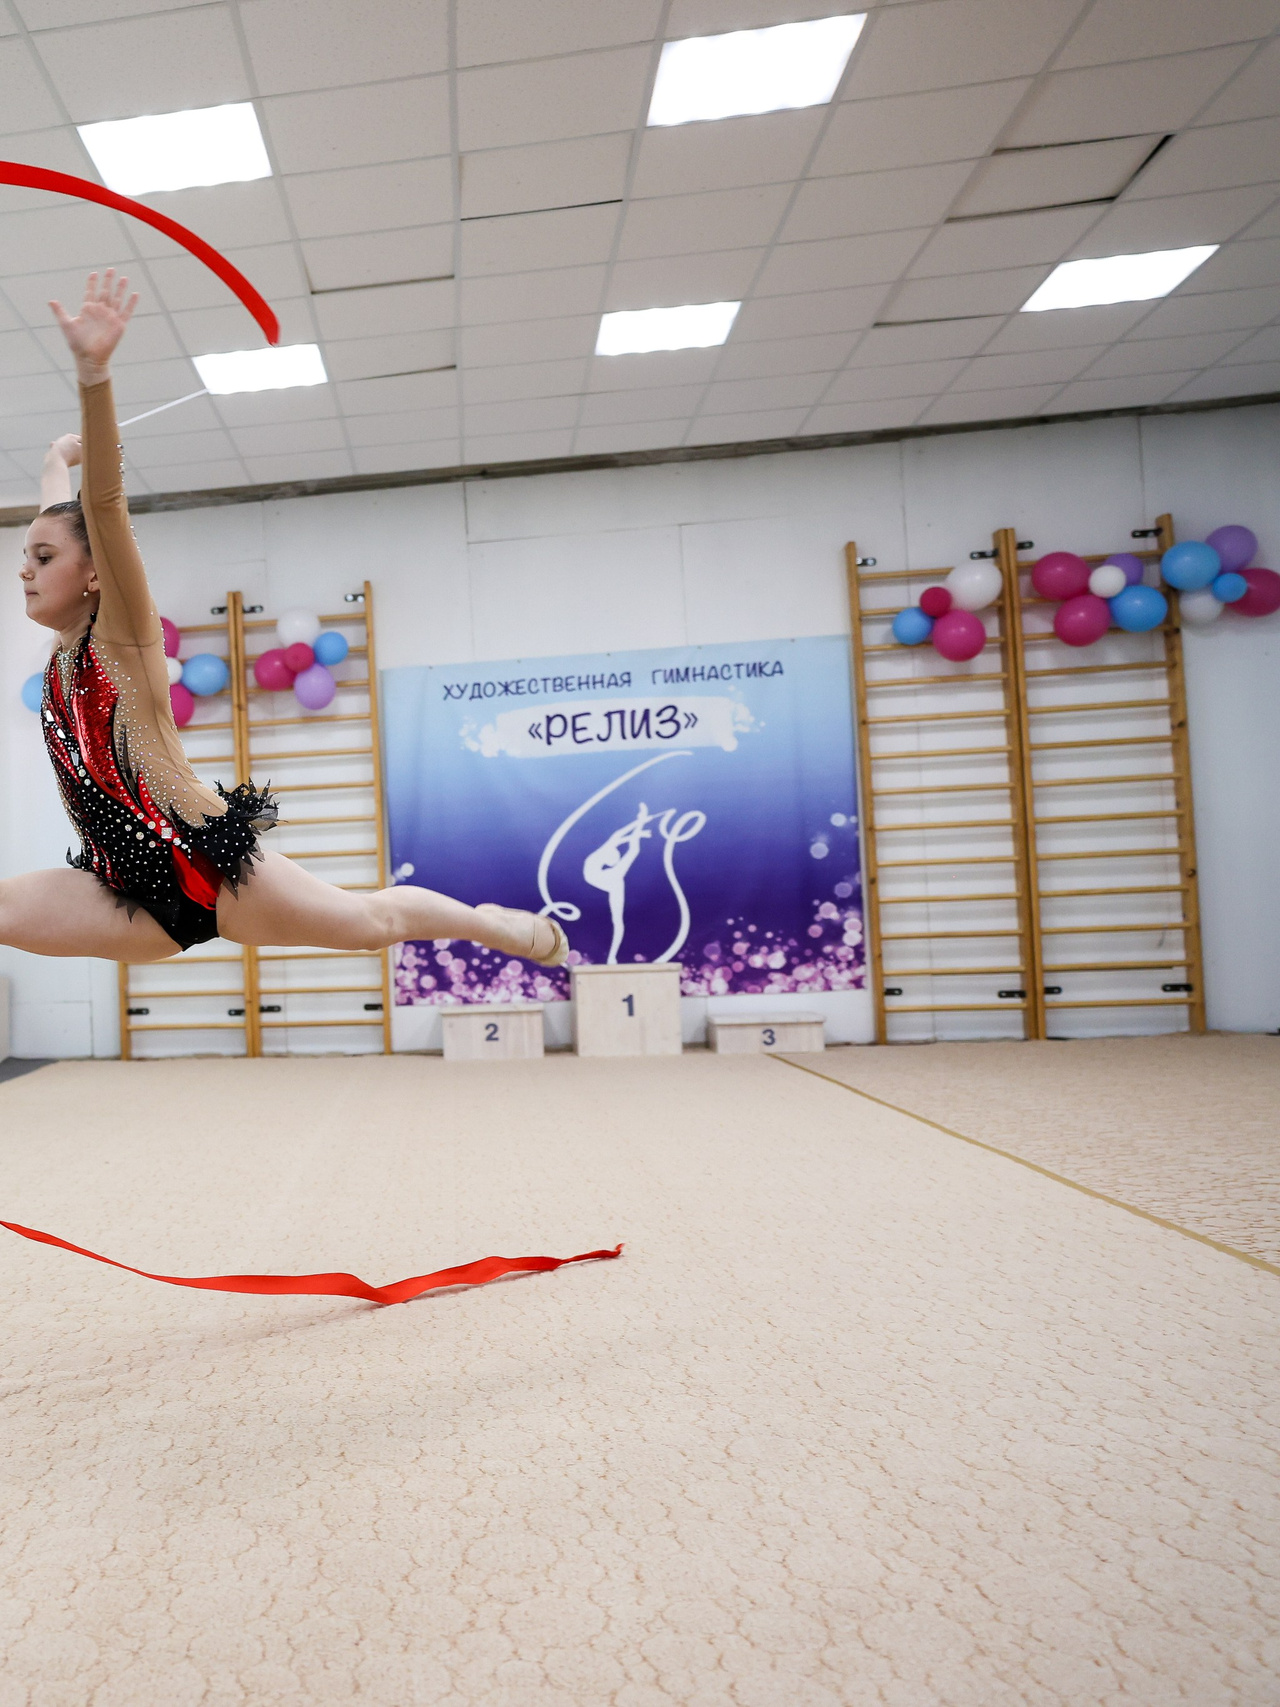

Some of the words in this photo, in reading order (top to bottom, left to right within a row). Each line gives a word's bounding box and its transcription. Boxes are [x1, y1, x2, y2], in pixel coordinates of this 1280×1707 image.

[443, 671, 632, 701] ХУДОЖЕСТВЕННАЯ
[651, 660, 784, 686] ГИМНАСТИКА
[528, 705, 698, 745] «РЕЛИЗ»
[621, 994, 635, 1017] 1
[484, 1023, 499, 1041] 2
[762, 1028, 776, 1046] 3
